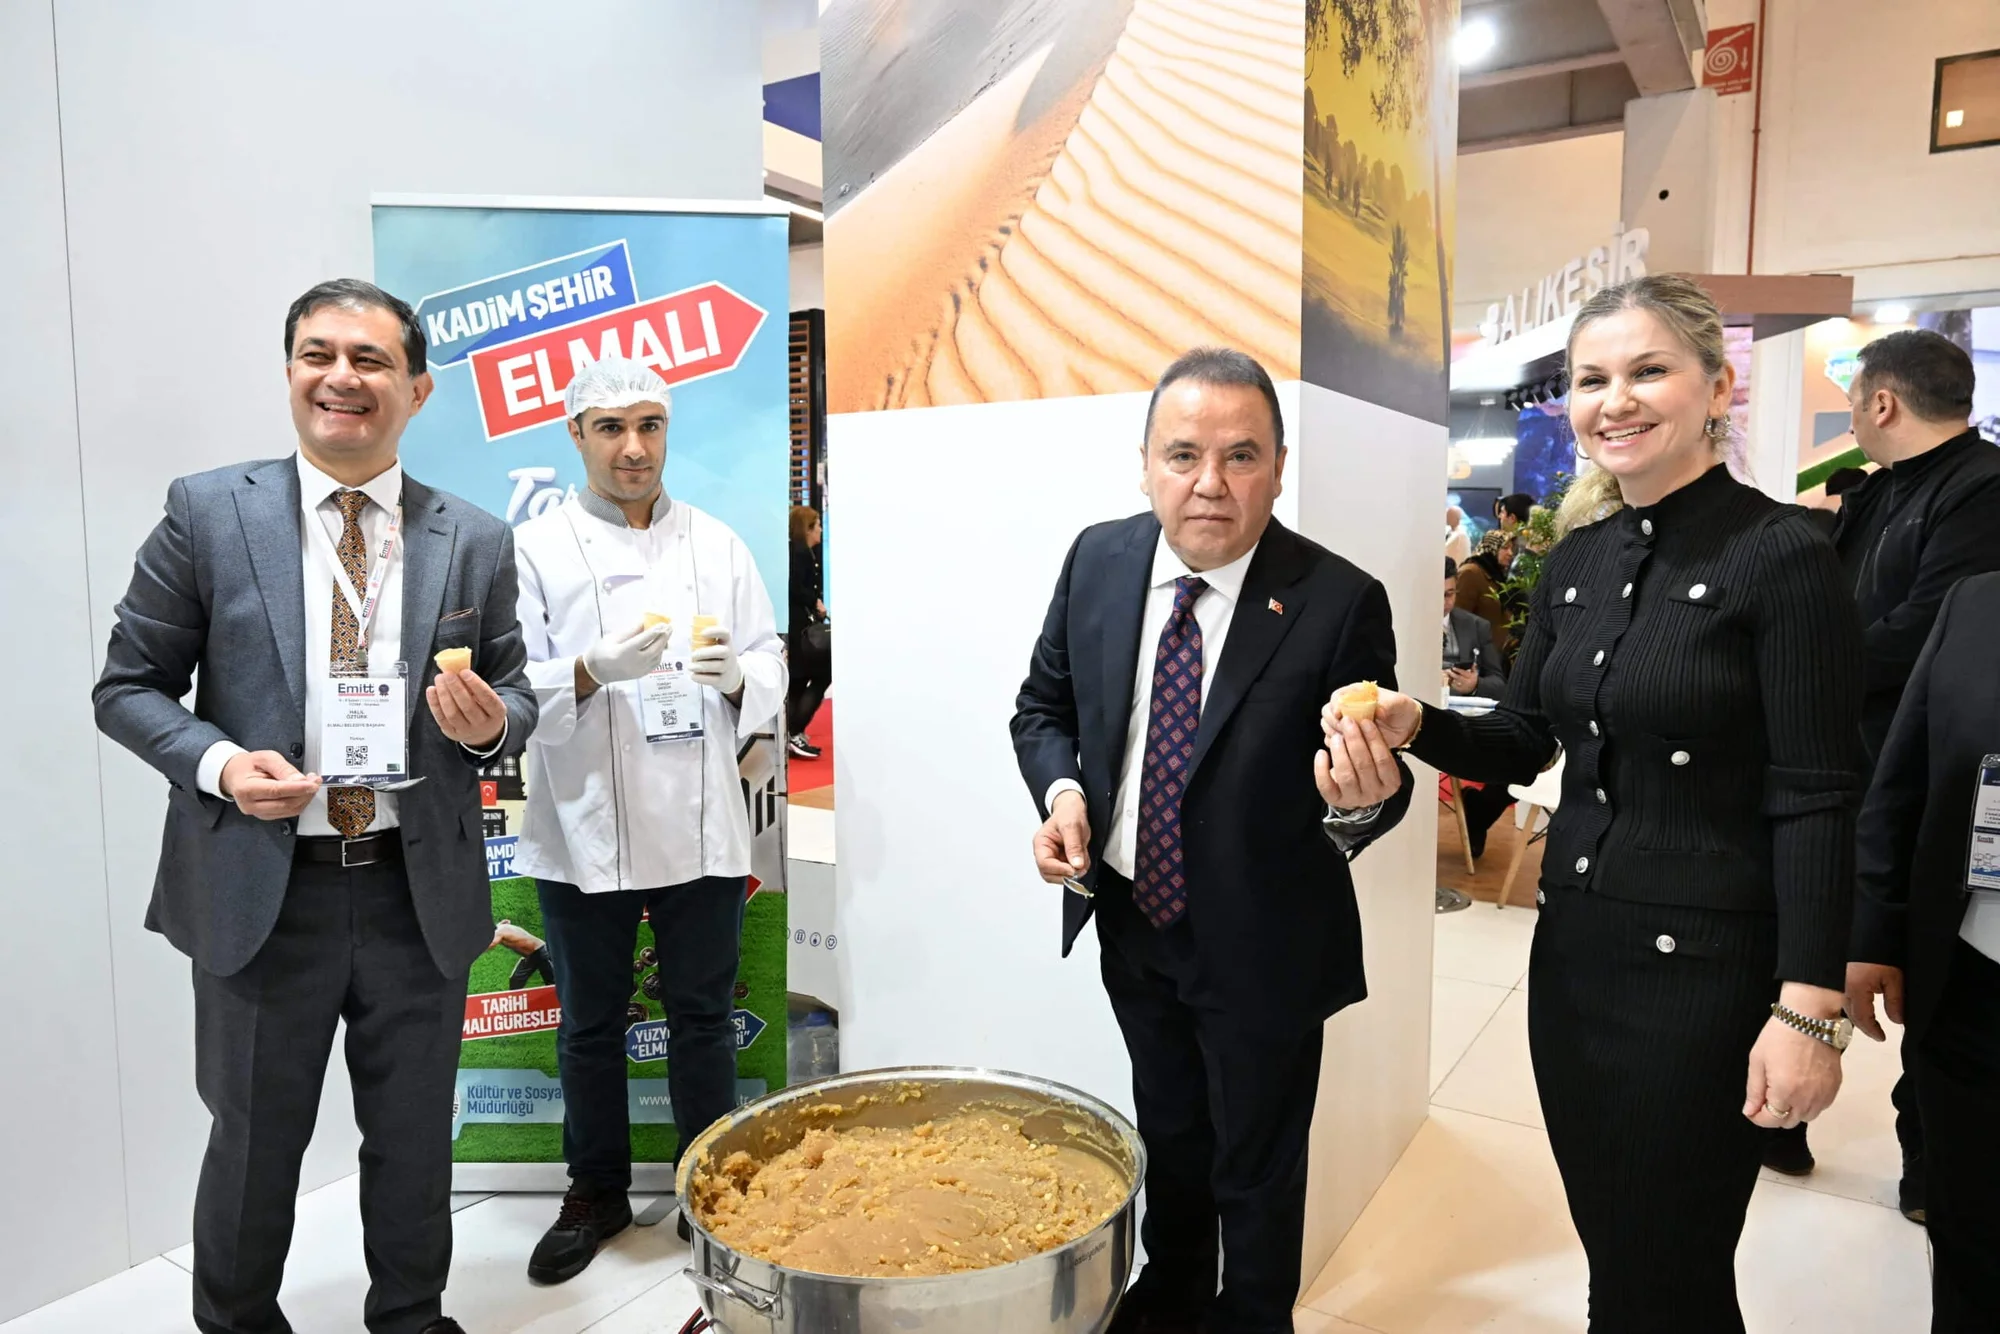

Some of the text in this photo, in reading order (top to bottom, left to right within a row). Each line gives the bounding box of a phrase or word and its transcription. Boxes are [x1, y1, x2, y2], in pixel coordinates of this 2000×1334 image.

[497, 300, 722, 417] ELMALI
[338, 683, 375, 694] Emitt
[463, 1016, 492, 1035] MALI
[467, 1085, 562, 1102] Kültür ve Sosya
[467, 1099, 534, 1117] Müdürlüğü
